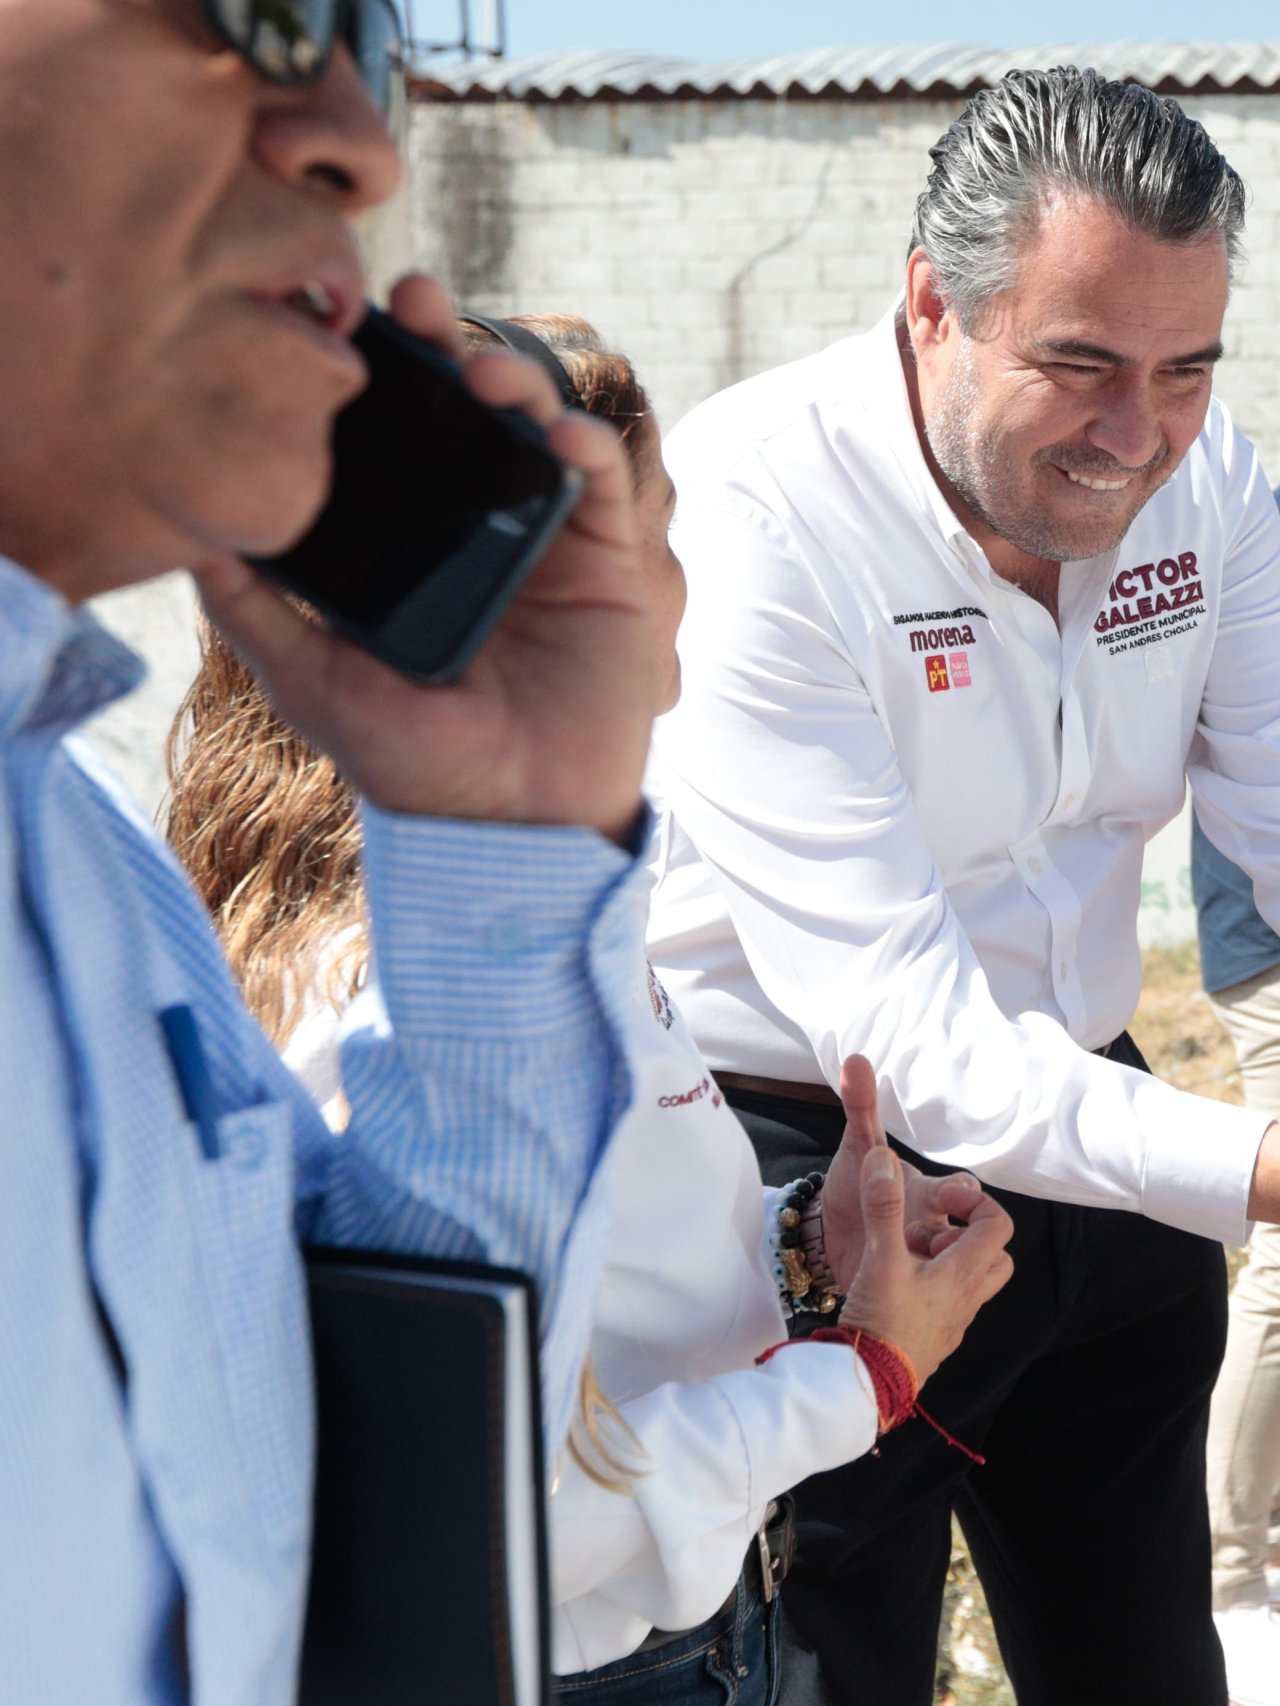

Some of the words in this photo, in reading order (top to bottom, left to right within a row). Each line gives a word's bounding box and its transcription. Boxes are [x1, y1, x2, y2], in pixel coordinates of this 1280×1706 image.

[1108, 551, 1200, 602] ICTOR
[893, 613, 924, 625] SIGAMOS
[1094, 580, 1204, 633] GALEAZZI
[909, 624, 976, 652] morena
[1096, 620, 1157, 647] PRESIDENTE
[1158, 604, 1206, 629] MUNICIPAL
[1108, 643, 1128, 656] SAN
[1129, 633, 1163, 649] ANDRES
[1163, 620, 1199, 639] CHOLULA
[929, 668, 947, 688] PT
